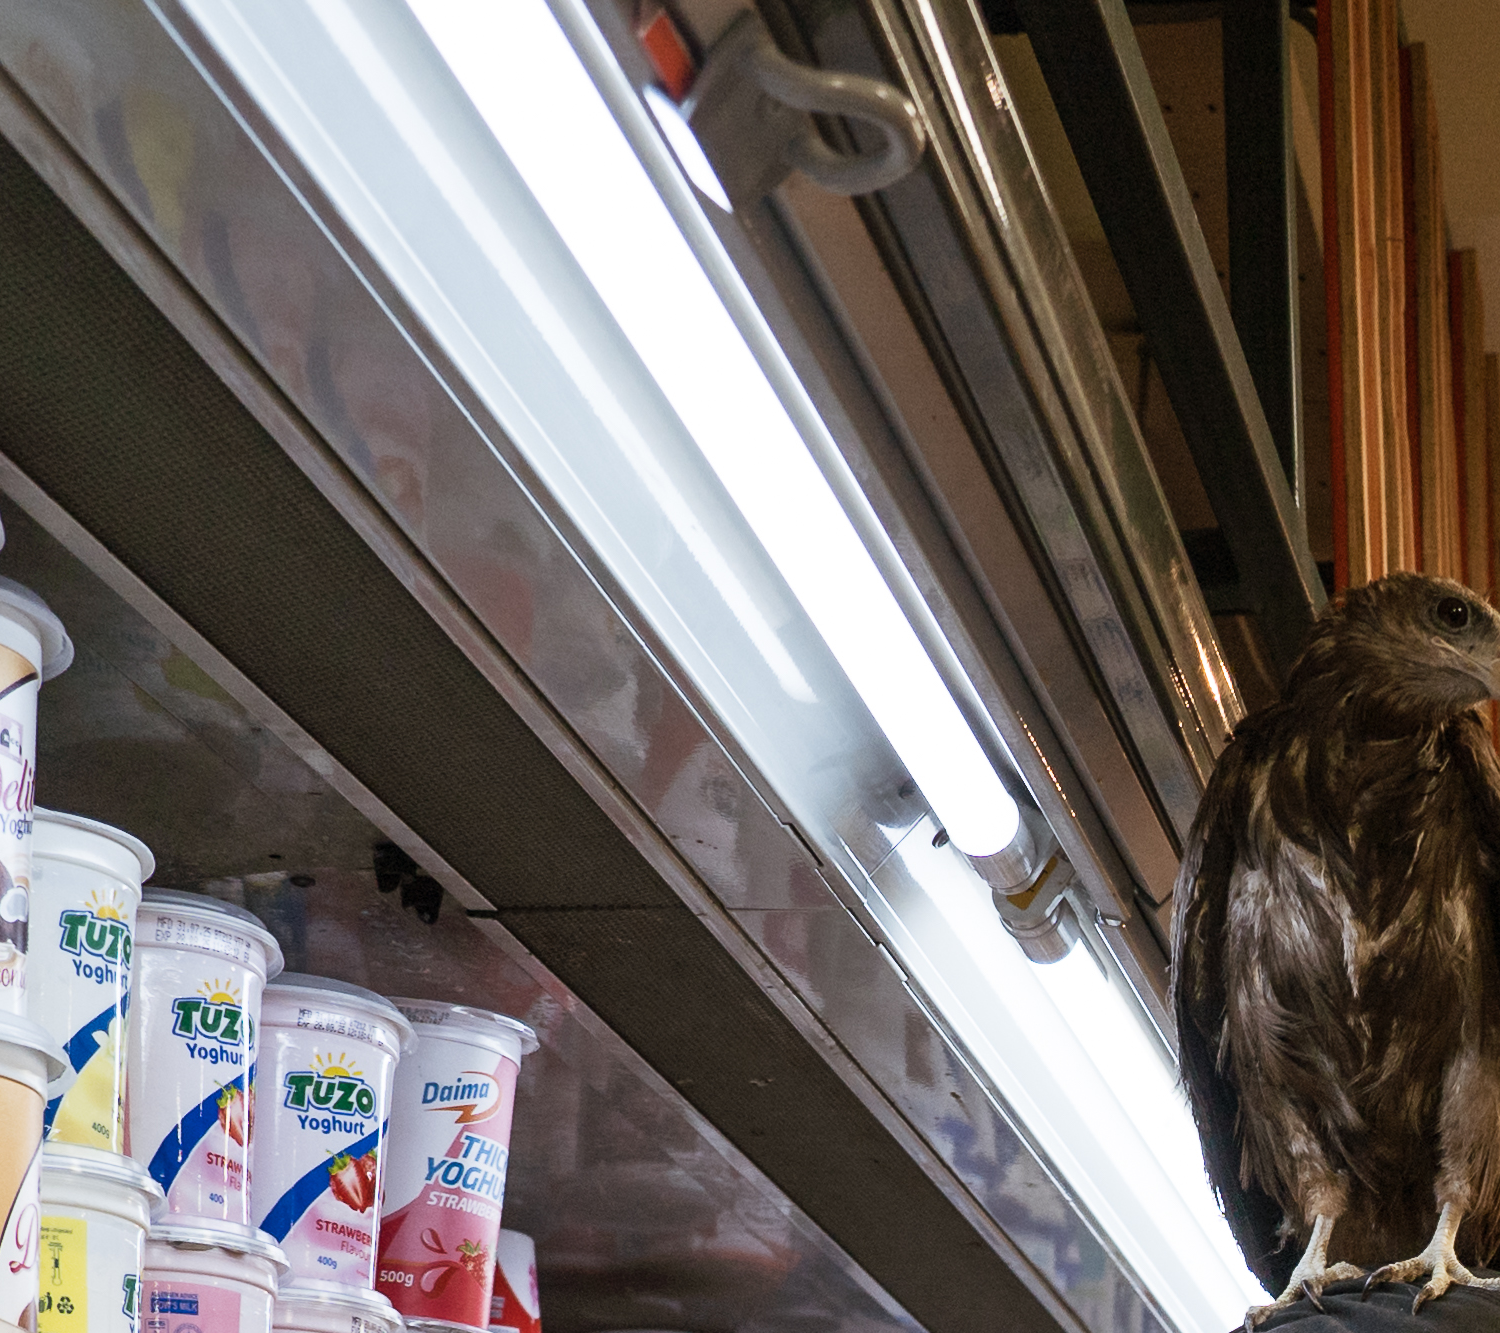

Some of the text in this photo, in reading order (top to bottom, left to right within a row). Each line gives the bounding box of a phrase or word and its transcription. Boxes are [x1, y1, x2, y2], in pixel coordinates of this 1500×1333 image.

[284, 1071, 377, 1120] TUZO
[421, 1077, 490, 1104] Daima
[297, 1114, 367, 1136] Yoghurt
[316, 1255, 338, 1270] 400g
[379, 1269, 414, 1288] 500g
